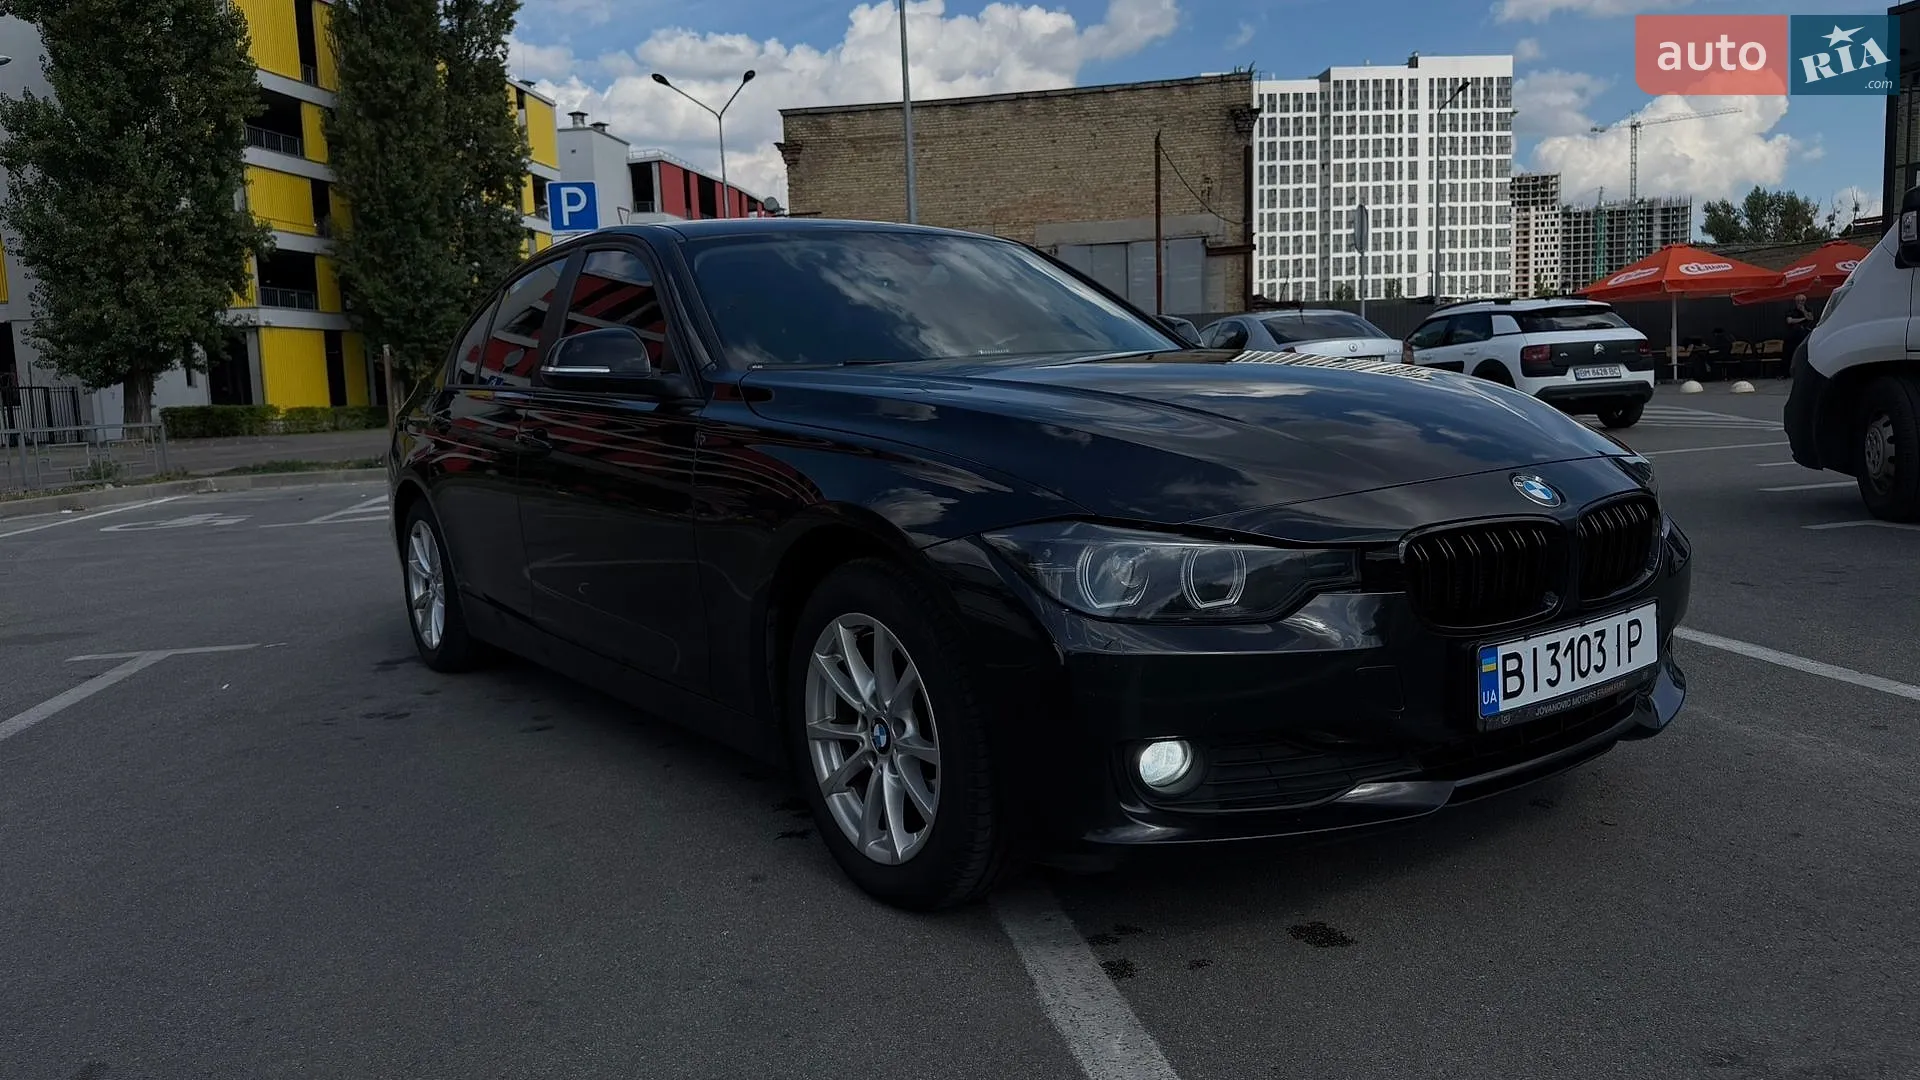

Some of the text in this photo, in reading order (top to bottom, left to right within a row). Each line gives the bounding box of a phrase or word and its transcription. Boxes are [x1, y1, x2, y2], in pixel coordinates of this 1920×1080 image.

[560, 186, 588, 227] P
[1546, 629, 1607, 688] 3103
[1616, 618, 1643, 668] IP
[1482, 690, 1498, 705] UA
[1572, 690, 1597, 708] MOTORS
